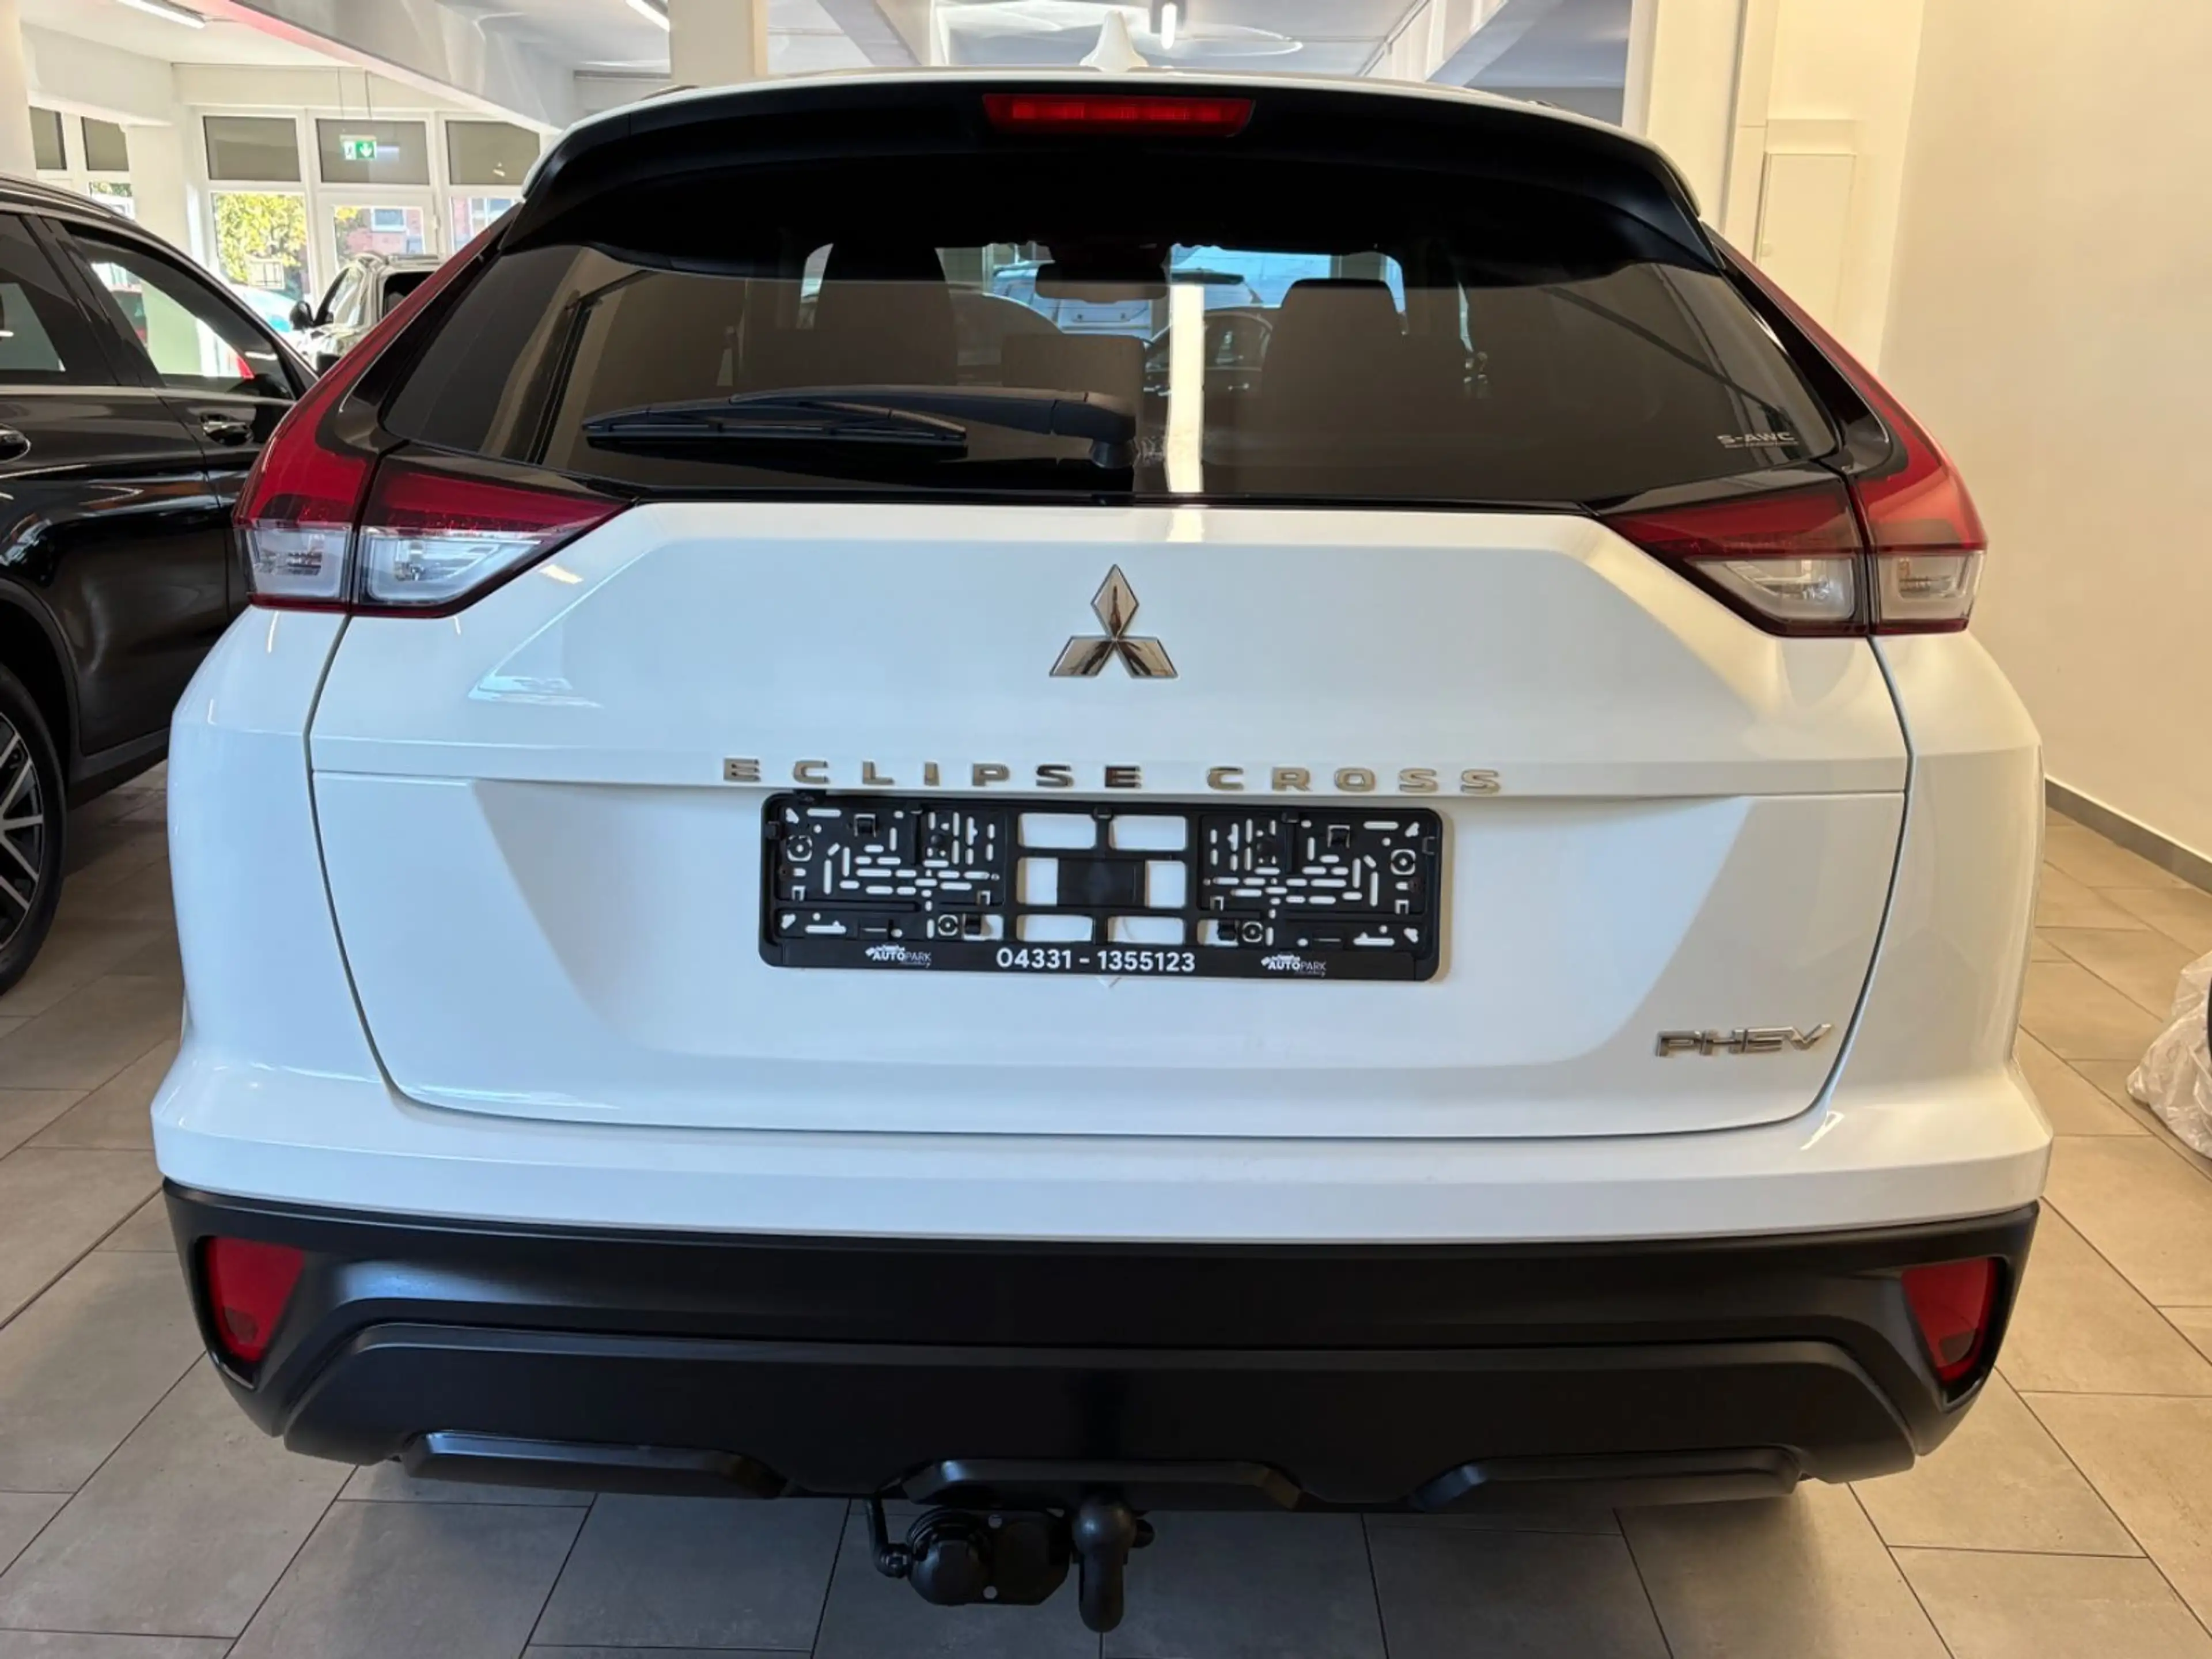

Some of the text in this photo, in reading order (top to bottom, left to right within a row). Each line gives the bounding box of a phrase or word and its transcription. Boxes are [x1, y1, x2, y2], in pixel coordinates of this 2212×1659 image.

[1717, 433, 1795, 444] S-AWC
[723, 757, 1501, 794] ECLIPSE CROSS
[997, 947, 1071, 969] 04331
[1097, 950, 1196, 972] 1355123
[1654, 1023, 1833, 1058] PHEV
